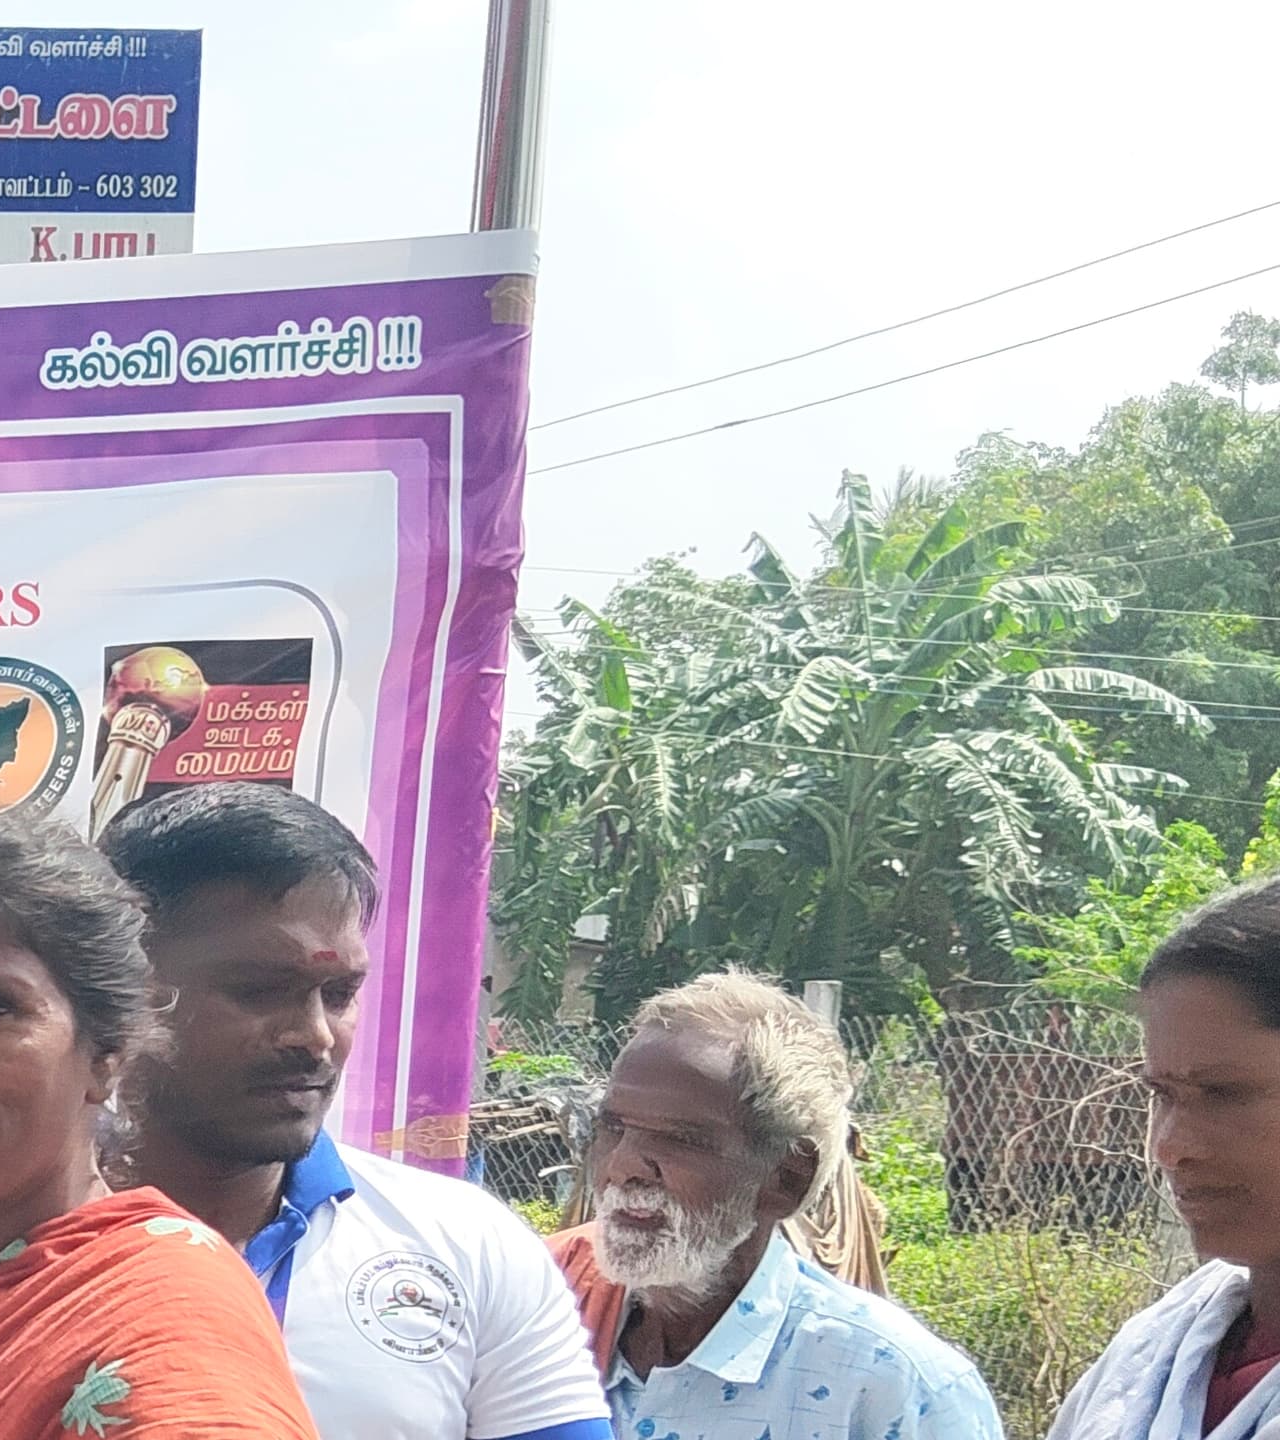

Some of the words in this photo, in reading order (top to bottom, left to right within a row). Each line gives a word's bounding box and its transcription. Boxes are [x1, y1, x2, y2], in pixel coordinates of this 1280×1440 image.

[29, 33, 123, 58] வளர்ச்சி
[95, 174, 134, 199] 603
[139, 174, 178, 200] 302
[44, 334, 173, 385] கல்வி
[184, 322, 369, 377] வளர்ச்சி
[205, 690, 308, 723] மக்கள்
